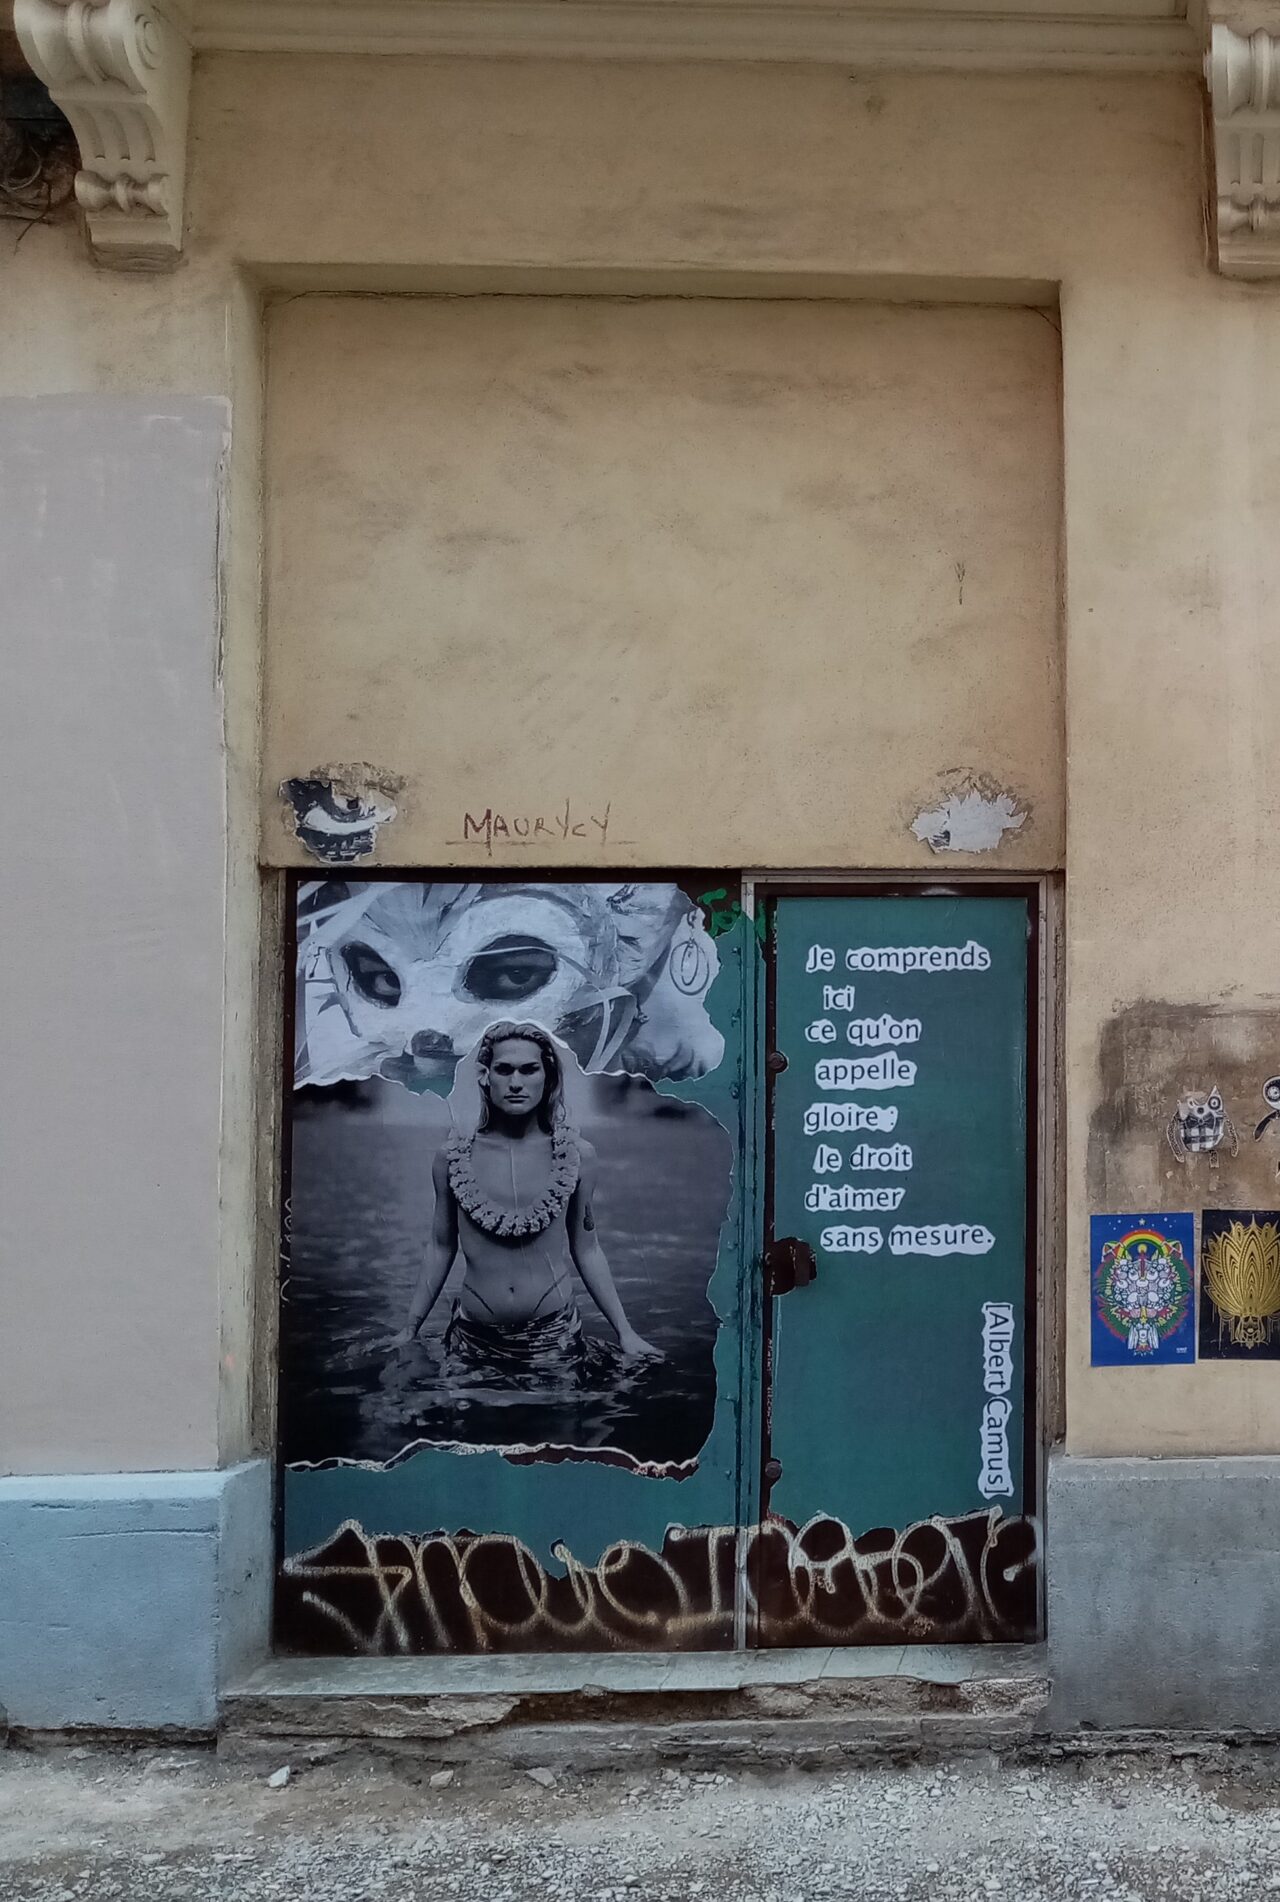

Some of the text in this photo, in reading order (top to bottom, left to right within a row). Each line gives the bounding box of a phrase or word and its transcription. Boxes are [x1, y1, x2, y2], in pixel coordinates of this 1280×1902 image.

[808, 945, 990, 973] Je comprends
[824, 987, 853, 1008] ici
[807, 1018, 920, 1046] ce qu'on
[817, 1058, 911, 1086] appelle
[805, 1105, 879, 1133] gloire
[818, 1144, 911, 1169] le droit
[805, 1186, 902, 1210] d'aimer
[821, 1226, 993, 1249] sans mesure.
